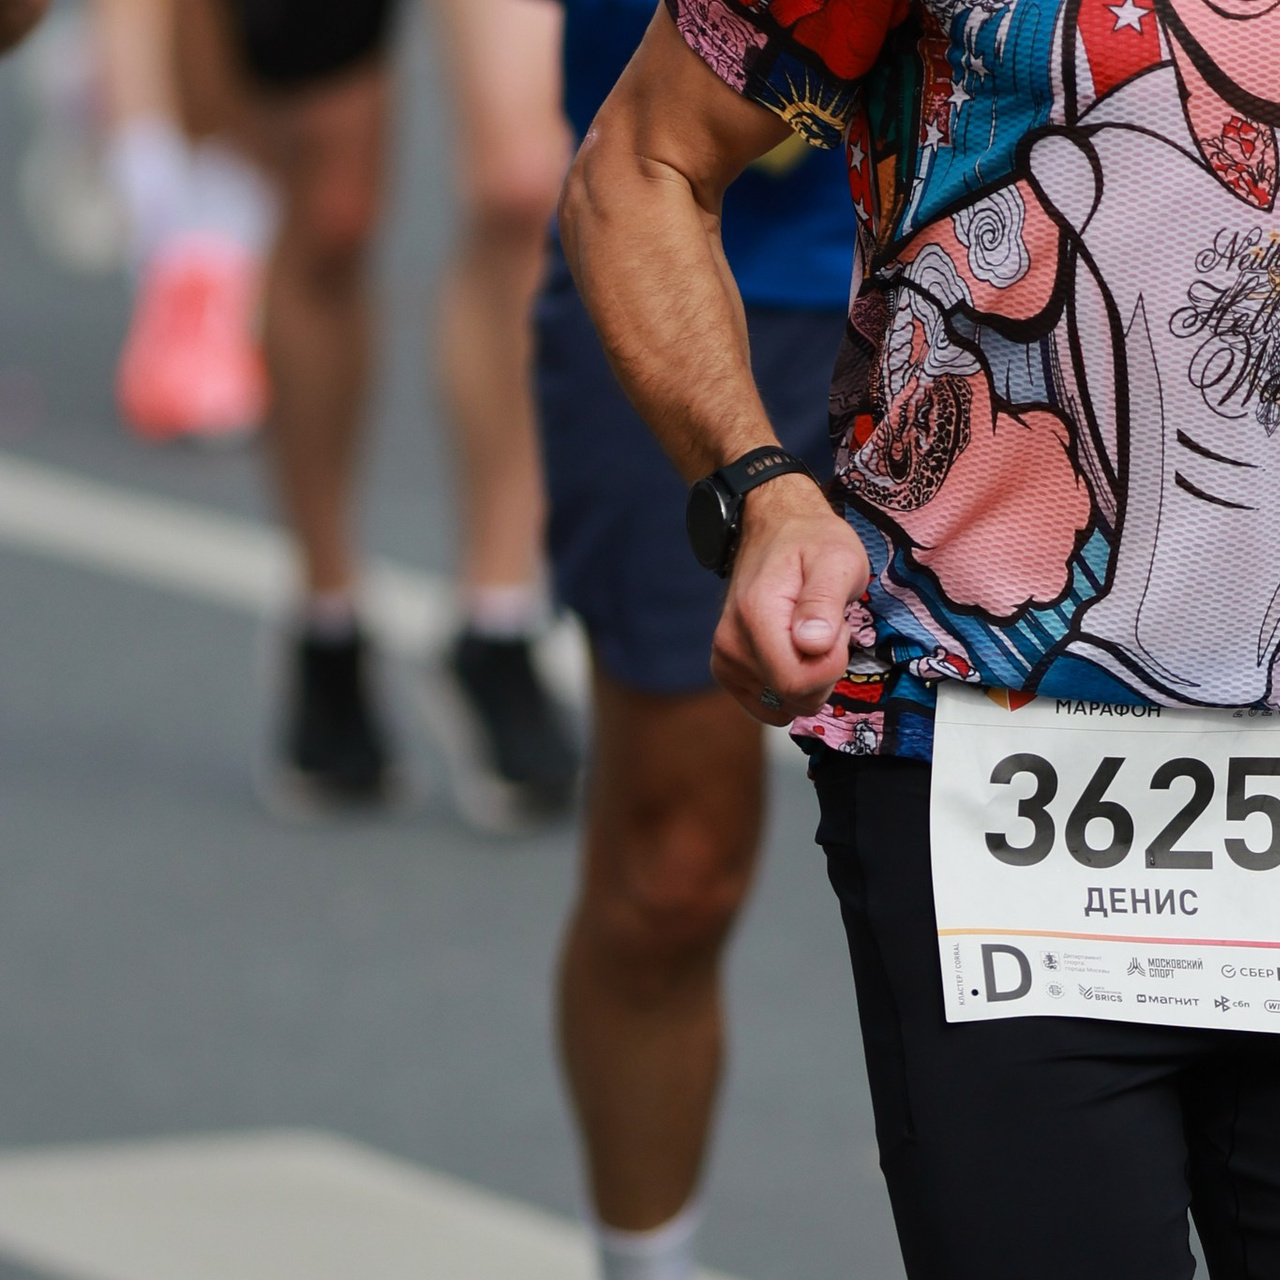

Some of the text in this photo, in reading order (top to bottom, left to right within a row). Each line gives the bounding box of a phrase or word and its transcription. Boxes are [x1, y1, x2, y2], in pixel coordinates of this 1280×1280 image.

[1056, 699, 1161, 718] МАРАФОН
[1084, 887, 1199, 918] ДЕНИС
[1148, 957, 1203, 970] МОСКОВСКИЙ
[981, 944, 1032, 1002] D
[1149, 968, 1174, 978] СПОРТ
[1240, 967, 1274, 977] СБЕР
[1095, 994, 1123, 1002] BRICS
